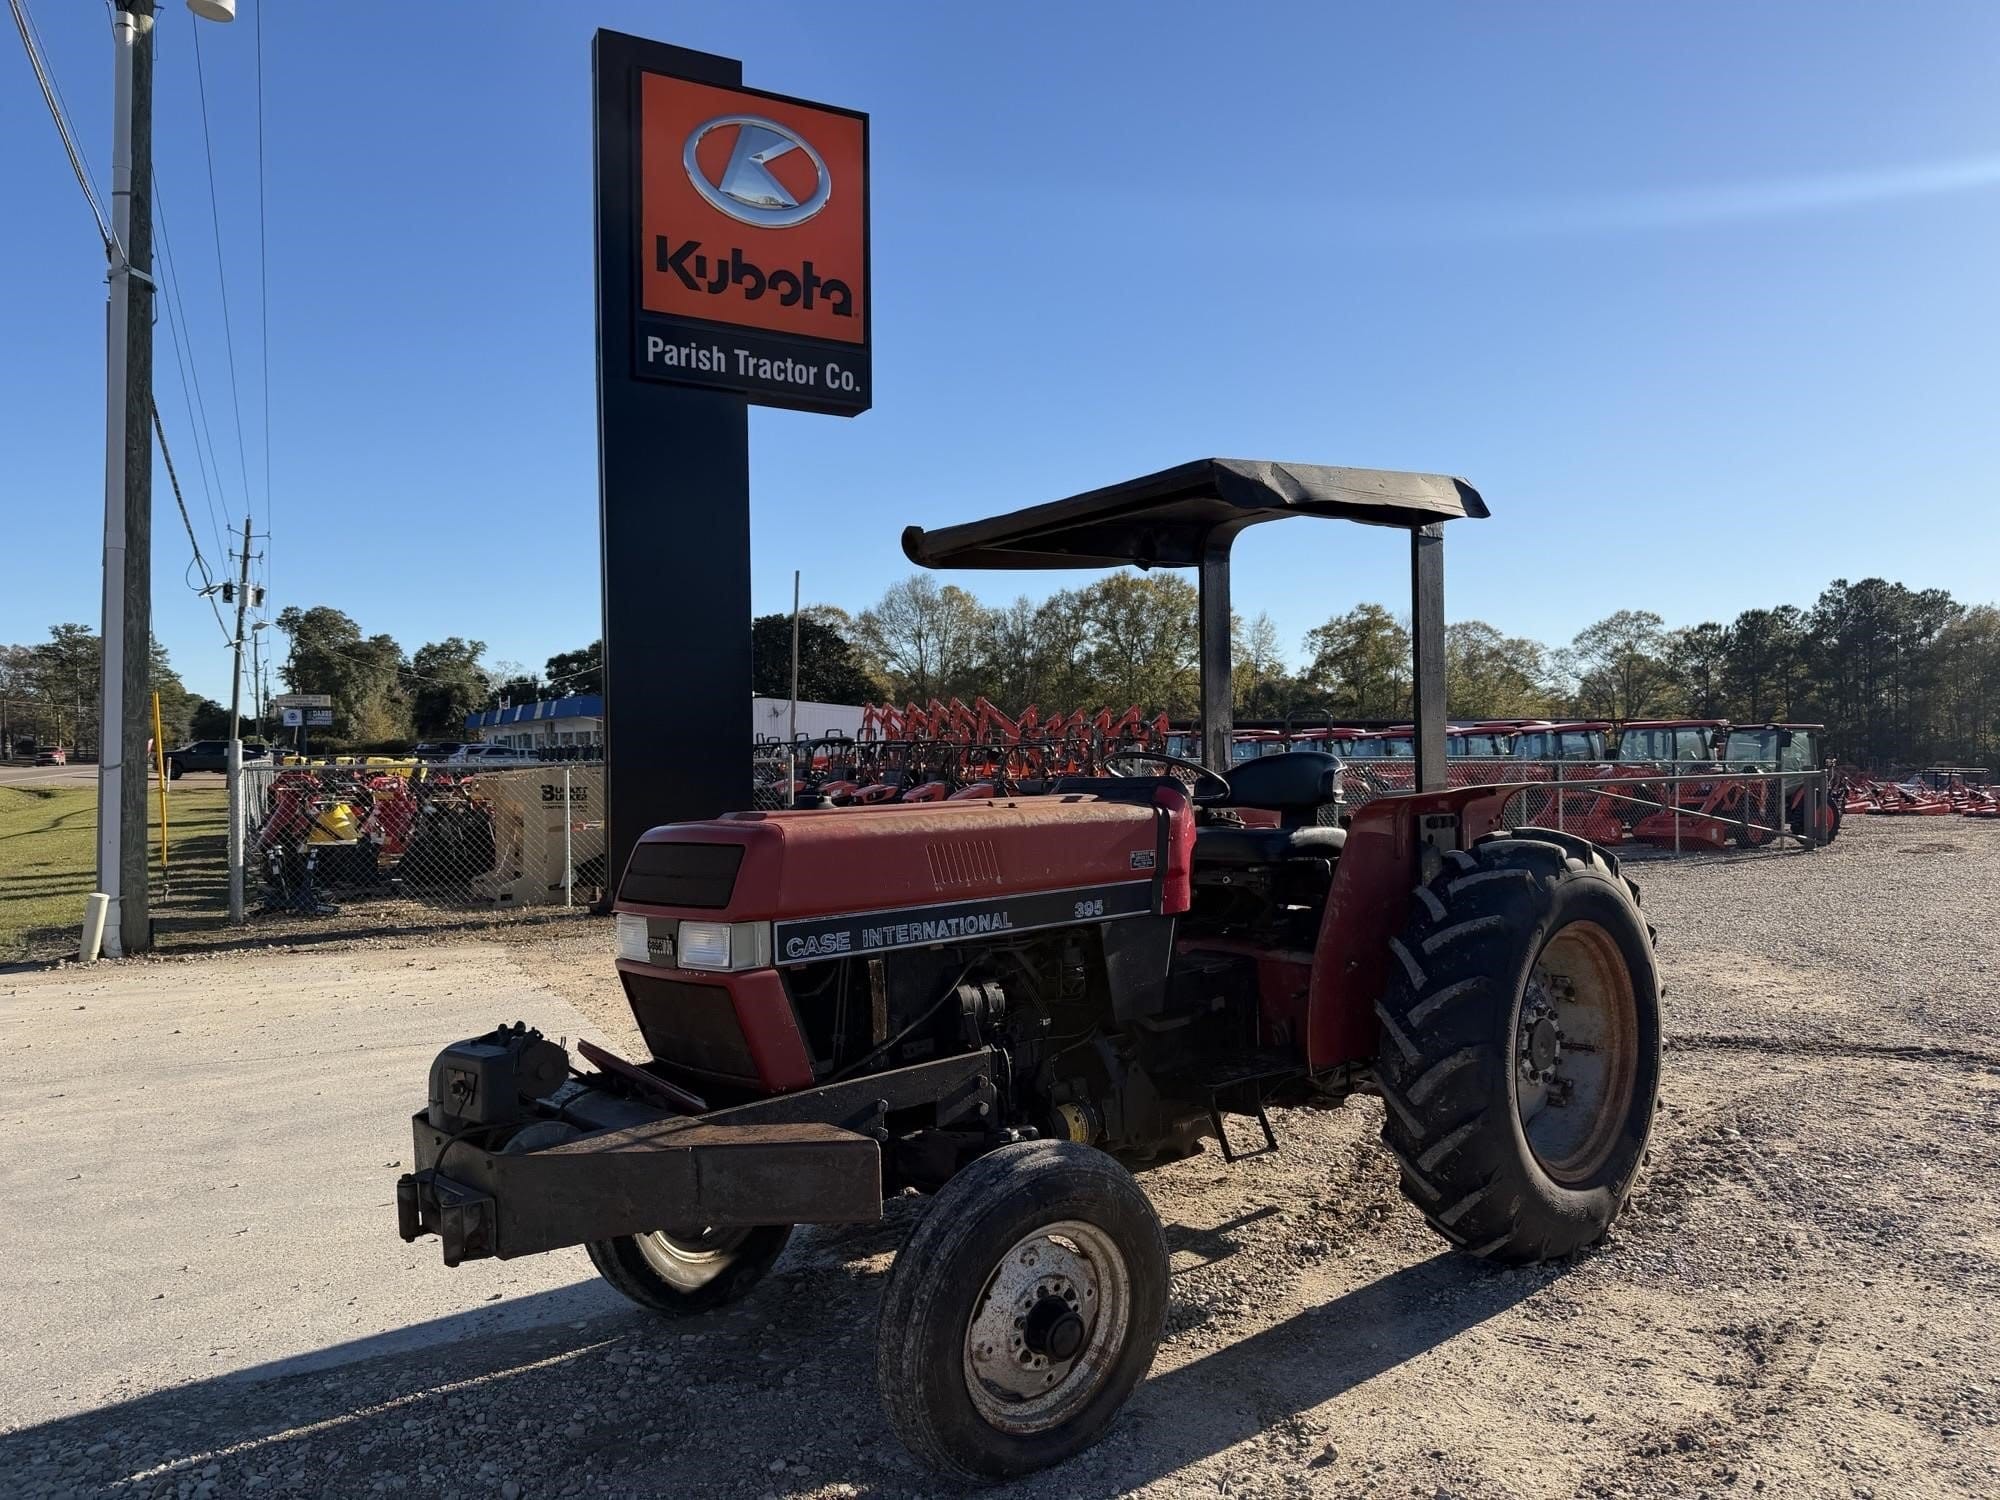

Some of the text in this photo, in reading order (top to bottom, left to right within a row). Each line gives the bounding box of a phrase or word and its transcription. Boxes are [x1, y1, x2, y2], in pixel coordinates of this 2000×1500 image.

[656, 235, 853, 318] Kubota
[647, 336, 861, 392] Parish Tractor Co.
[786, 900, 1104, 958] CASE INTERNATIONAL 395
